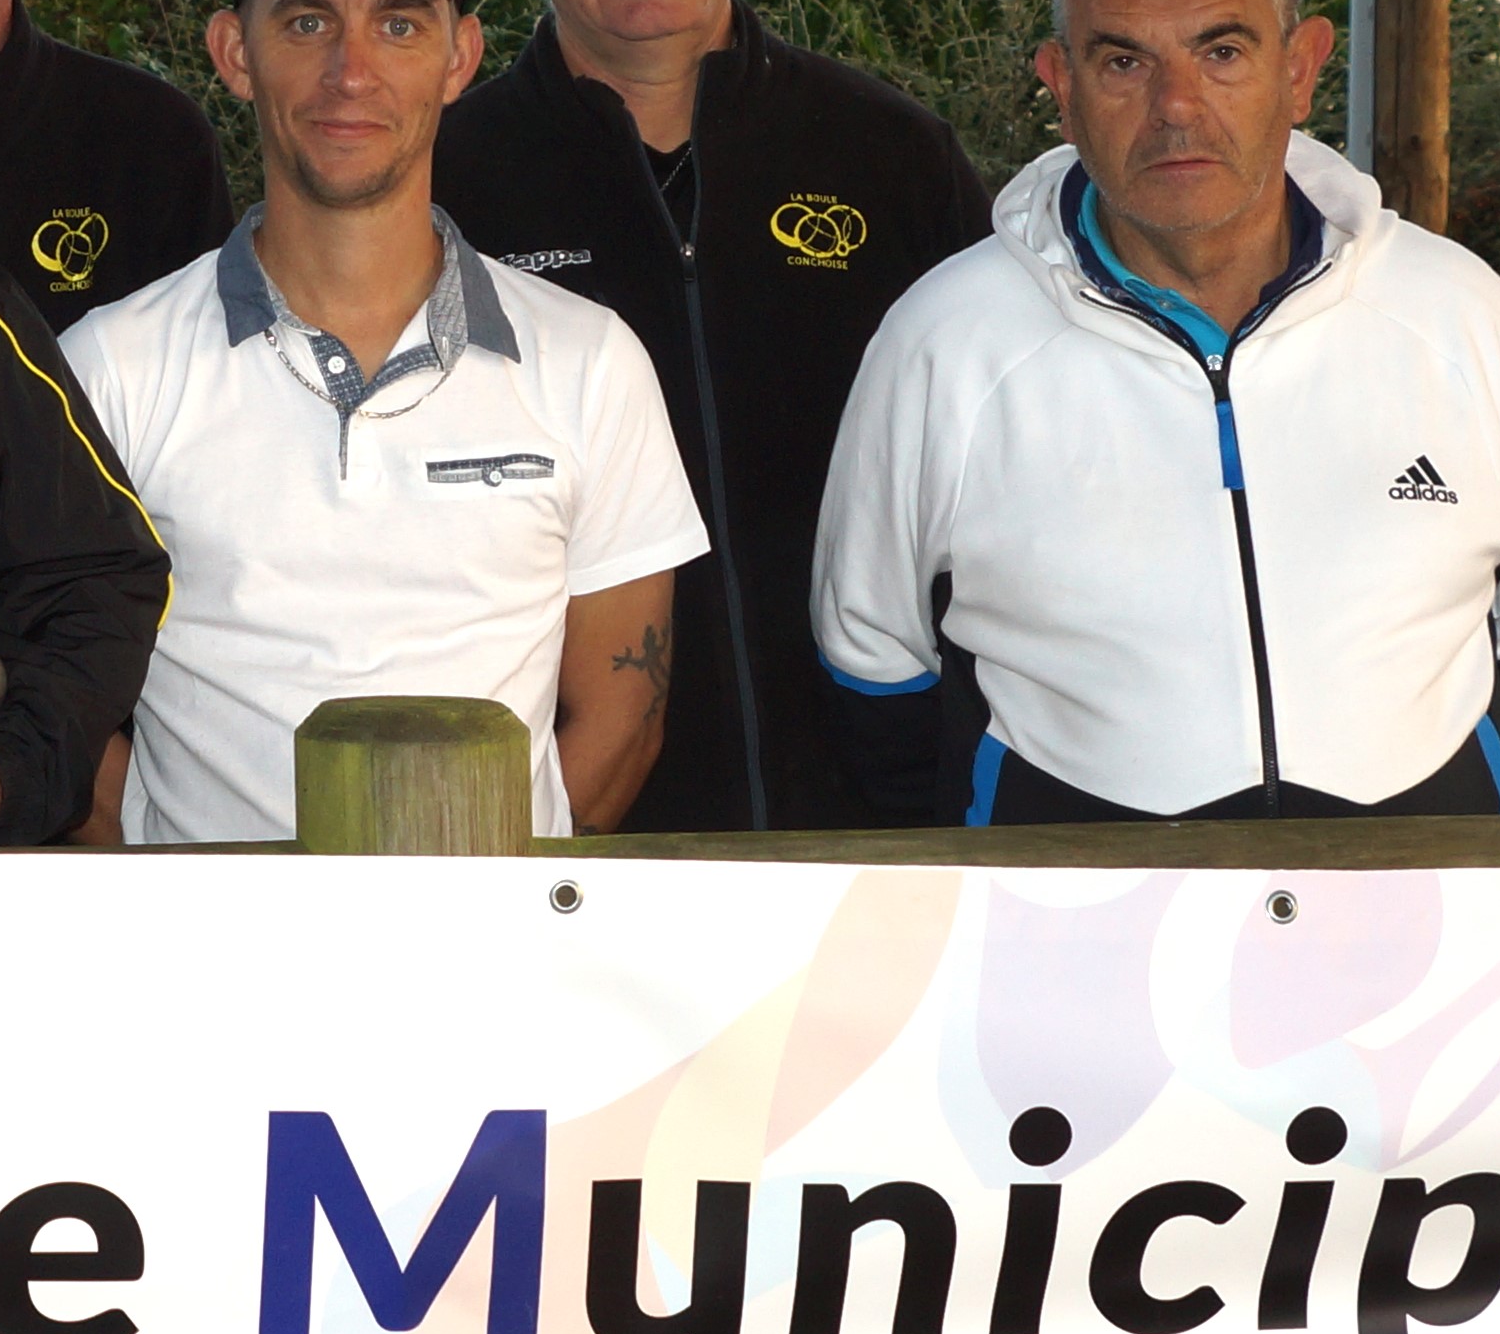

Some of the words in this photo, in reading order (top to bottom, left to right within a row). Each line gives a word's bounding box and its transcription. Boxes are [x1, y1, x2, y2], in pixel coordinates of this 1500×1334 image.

[790, 192, 804, 202] LA
[806, 193, 838, 204] BOULE
[52, 208, 64, 219] LA
[786, 255, 849, 270] CONCHOISE
[1388, 483, 1459, 505] adidas
